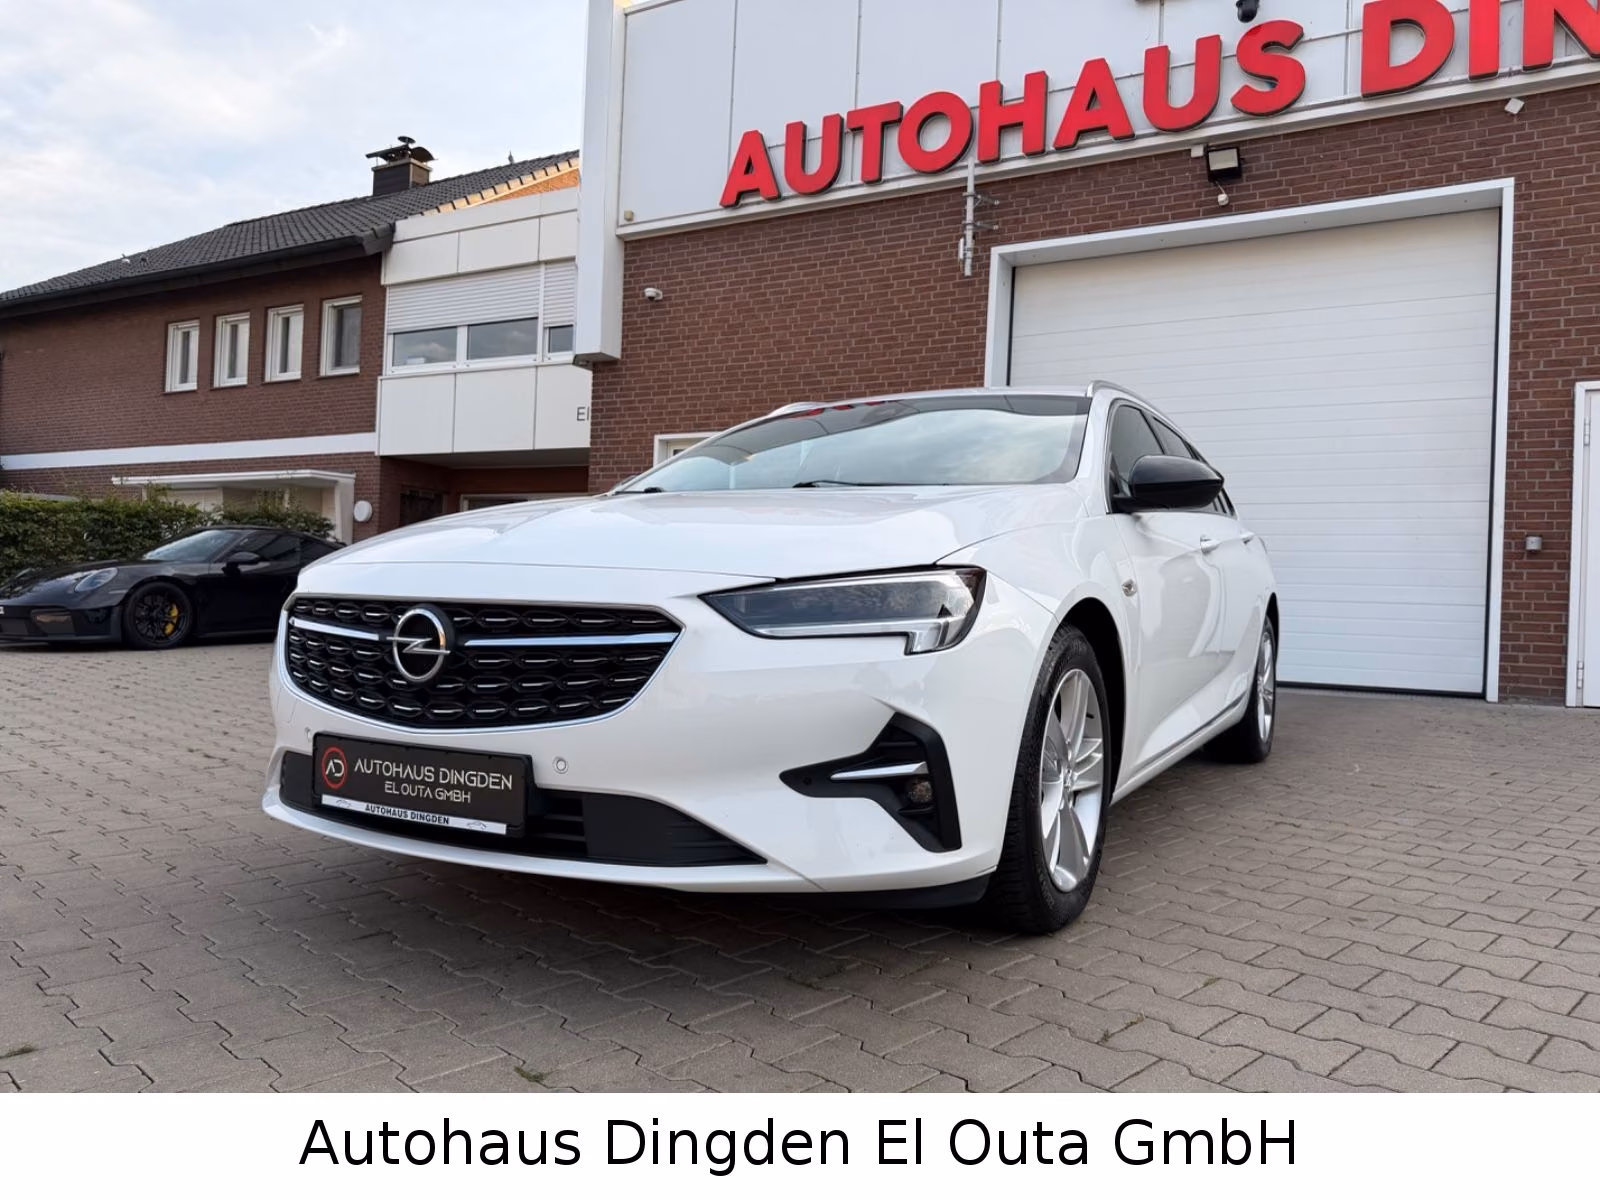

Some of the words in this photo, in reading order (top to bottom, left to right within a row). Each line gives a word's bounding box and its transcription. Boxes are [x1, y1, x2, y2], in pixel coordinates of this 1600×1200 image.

[719, 19, 1307, 208] AUTOHAUS
[354, 757, 435, 783] AUTOHAUS
[439, 766, 513, 790] DINGDEN
[384, 780, 400, 795] EL
[400, 783, 433, 799] OUTA
[434, 787, 472, 803] GMBH
[364, 803, 409, 819] AUTOHAUS
[410, 811, 450, 825] DINGDEN
